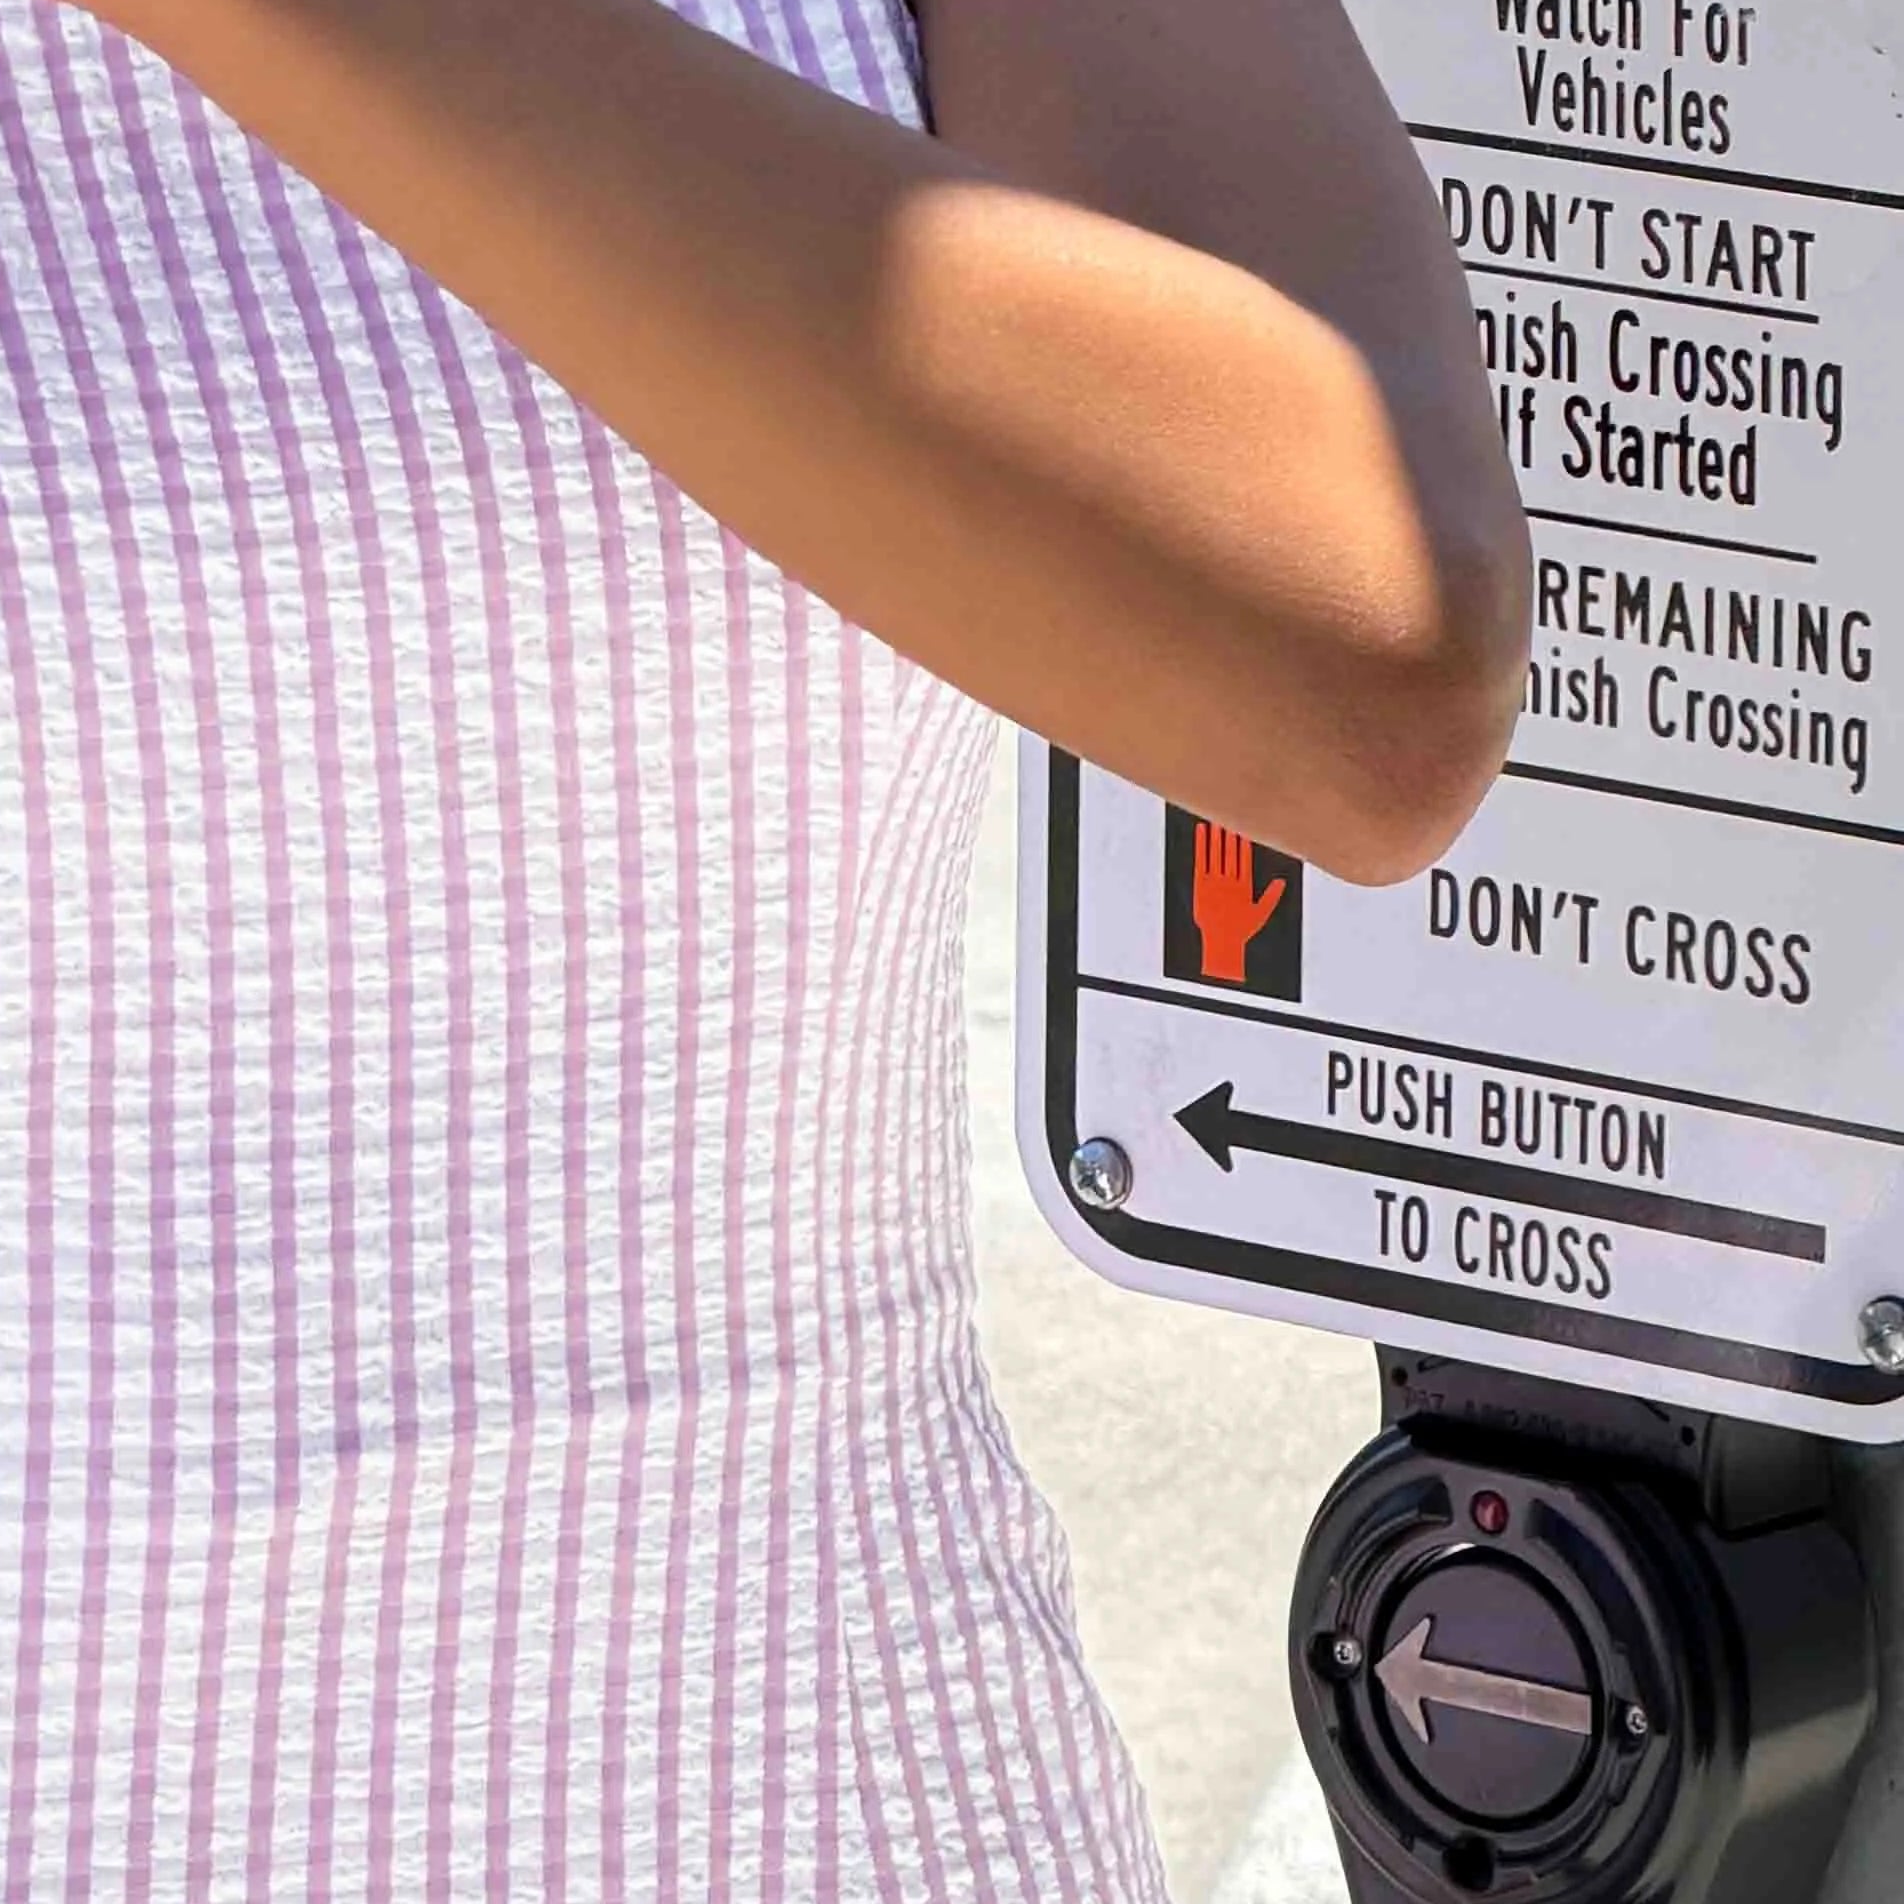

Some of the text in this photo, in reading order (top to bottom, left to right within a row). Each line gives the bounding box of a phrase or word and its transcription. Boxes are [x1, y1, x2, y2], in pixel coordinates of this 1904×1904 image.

[1517, 46, 1731, 154] Vehicles
[1442, 177, 1816, 301] DON'T START
[1475, 291, 1843, 452] nish Crossing
[1562, 395, 1756, 506] Started
[1538, 558, 1872, 682] REMAINING
[1521, 646, 1869, 794] nish Crossing
[1430, 868, 1811, 1004] DON'T CROSS
[1327, 1049, 1667, 1179] PUSH BUTTON
[1374, 1189, 1613, 1300] TO CROSS
